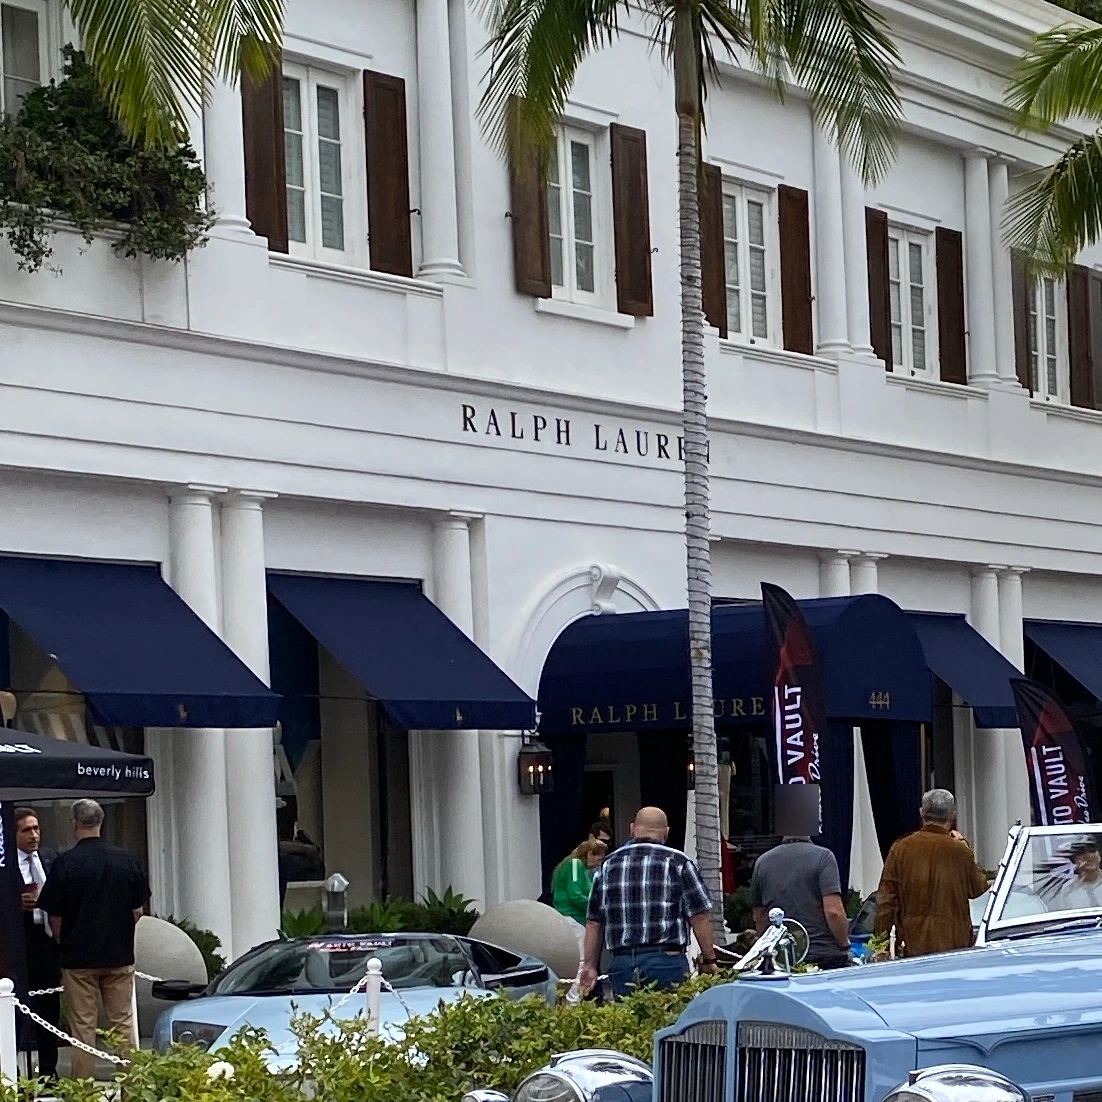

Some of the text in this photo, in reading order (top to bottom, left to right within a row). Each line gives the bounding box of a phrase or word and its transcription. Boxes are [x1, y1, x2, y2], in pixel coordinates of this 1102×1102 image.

[461, 404, 711, 465] RALPH LAURE
[571, 697, 766, 725] RALPH LURE
[868, 691, 890, 710] 444
[784, 684, 805, 766] VAULT
[77, 762, 150, 780] beverly hills
[1041, 745, 1069, 800] VAULT
